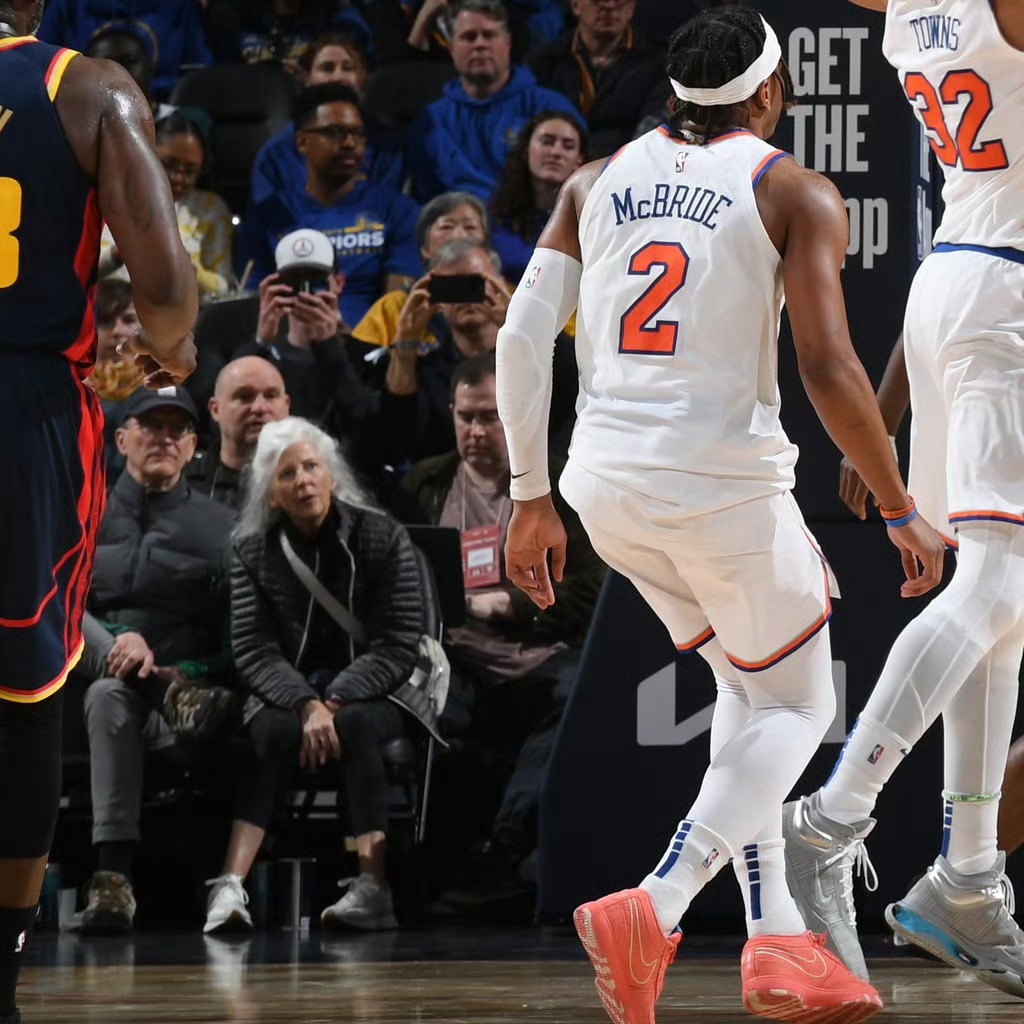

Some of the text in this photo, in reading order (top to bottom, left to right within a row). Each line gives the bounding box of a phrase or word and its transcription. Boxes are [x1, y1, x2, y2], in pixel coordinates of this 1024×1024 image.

[788, 27, 869, 97] GET
[910, 15, 961, 52] TOWNS
[786, 104, 870, 172] THE
[904, 69, 1009, 171] 32
[611, 183, 733, 230] McBRIDE
[843, 197, 889, 269] pp
[618, 240, 690, 356] 2
